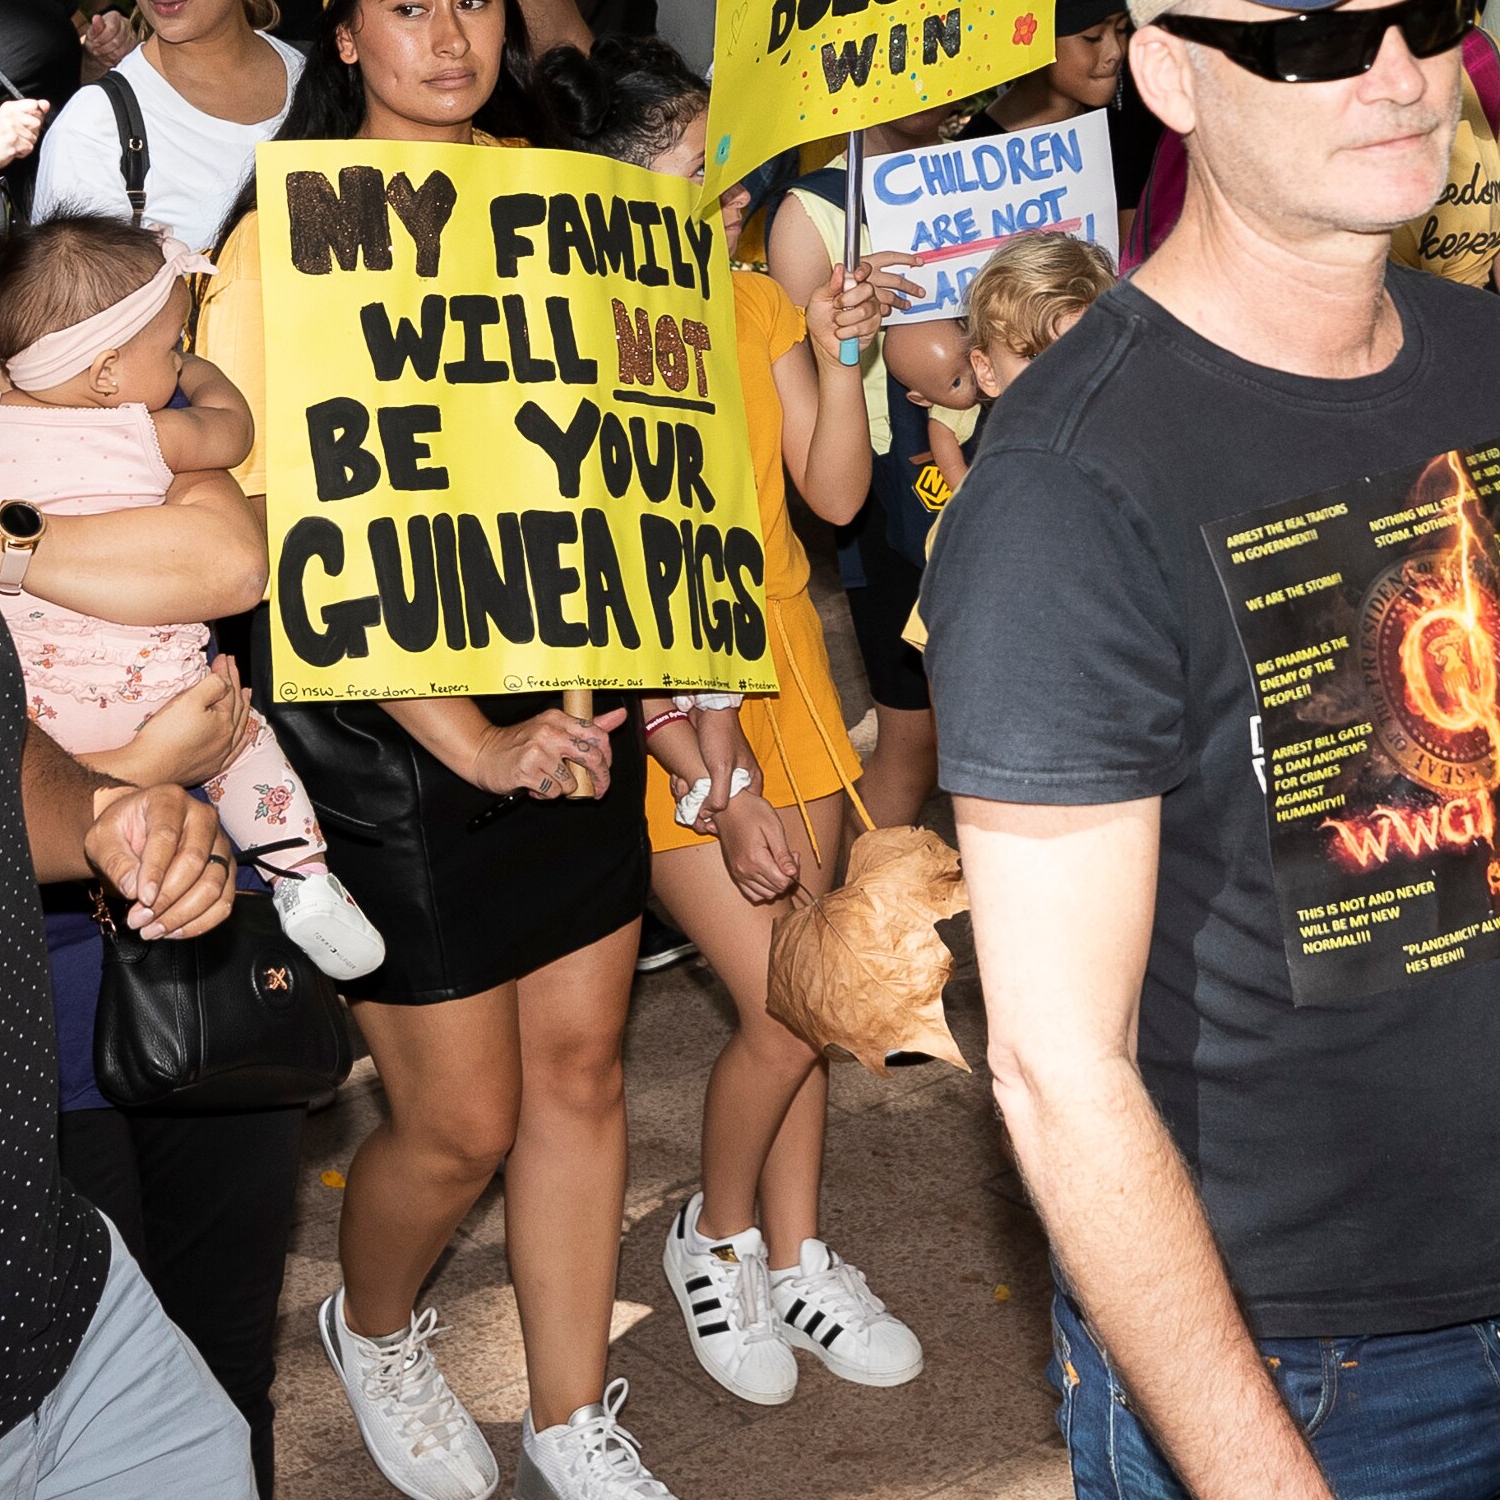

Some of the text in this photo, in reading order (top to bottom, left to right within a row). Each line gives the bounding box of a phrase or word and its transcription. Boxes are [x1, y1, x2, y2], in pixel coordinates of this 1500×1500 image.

[821, 8, 962, 95] WIN
[873, 128, 1084, 206] CHILDREN
[285, 165, 714, 300] MY FAMILY
[910, 186, 1068, 251] ARE NOT
[360, 294, 713, 399] WILL NOT
[306, 396, 716, 513] BE YOUR
[1226, 502, 1349, 548] ARREST THE REAL TRAITORS
[1231, 550, 1246, 564] IN
[277, 508, 766, 667] GUINEA PIGS
[1255, 635, 1350, 676] BIG PHARMA IS THE
[1259, 658, 1336, 692] ENEMY OF THE
[1272, 722, 1374, 761] ARREST BILL GATES
[1273, 740, 1368, 776] & DAN ANDREWS
[1274, 764, 1341, 791] FOR CRIMES
[1275, 785, 1324, 808] AGAINST
[1297, 881, 1435, 922] THIS IS NOT AND NEVER
[1300, 906, 1401, 938] WILL BE MY NEW
